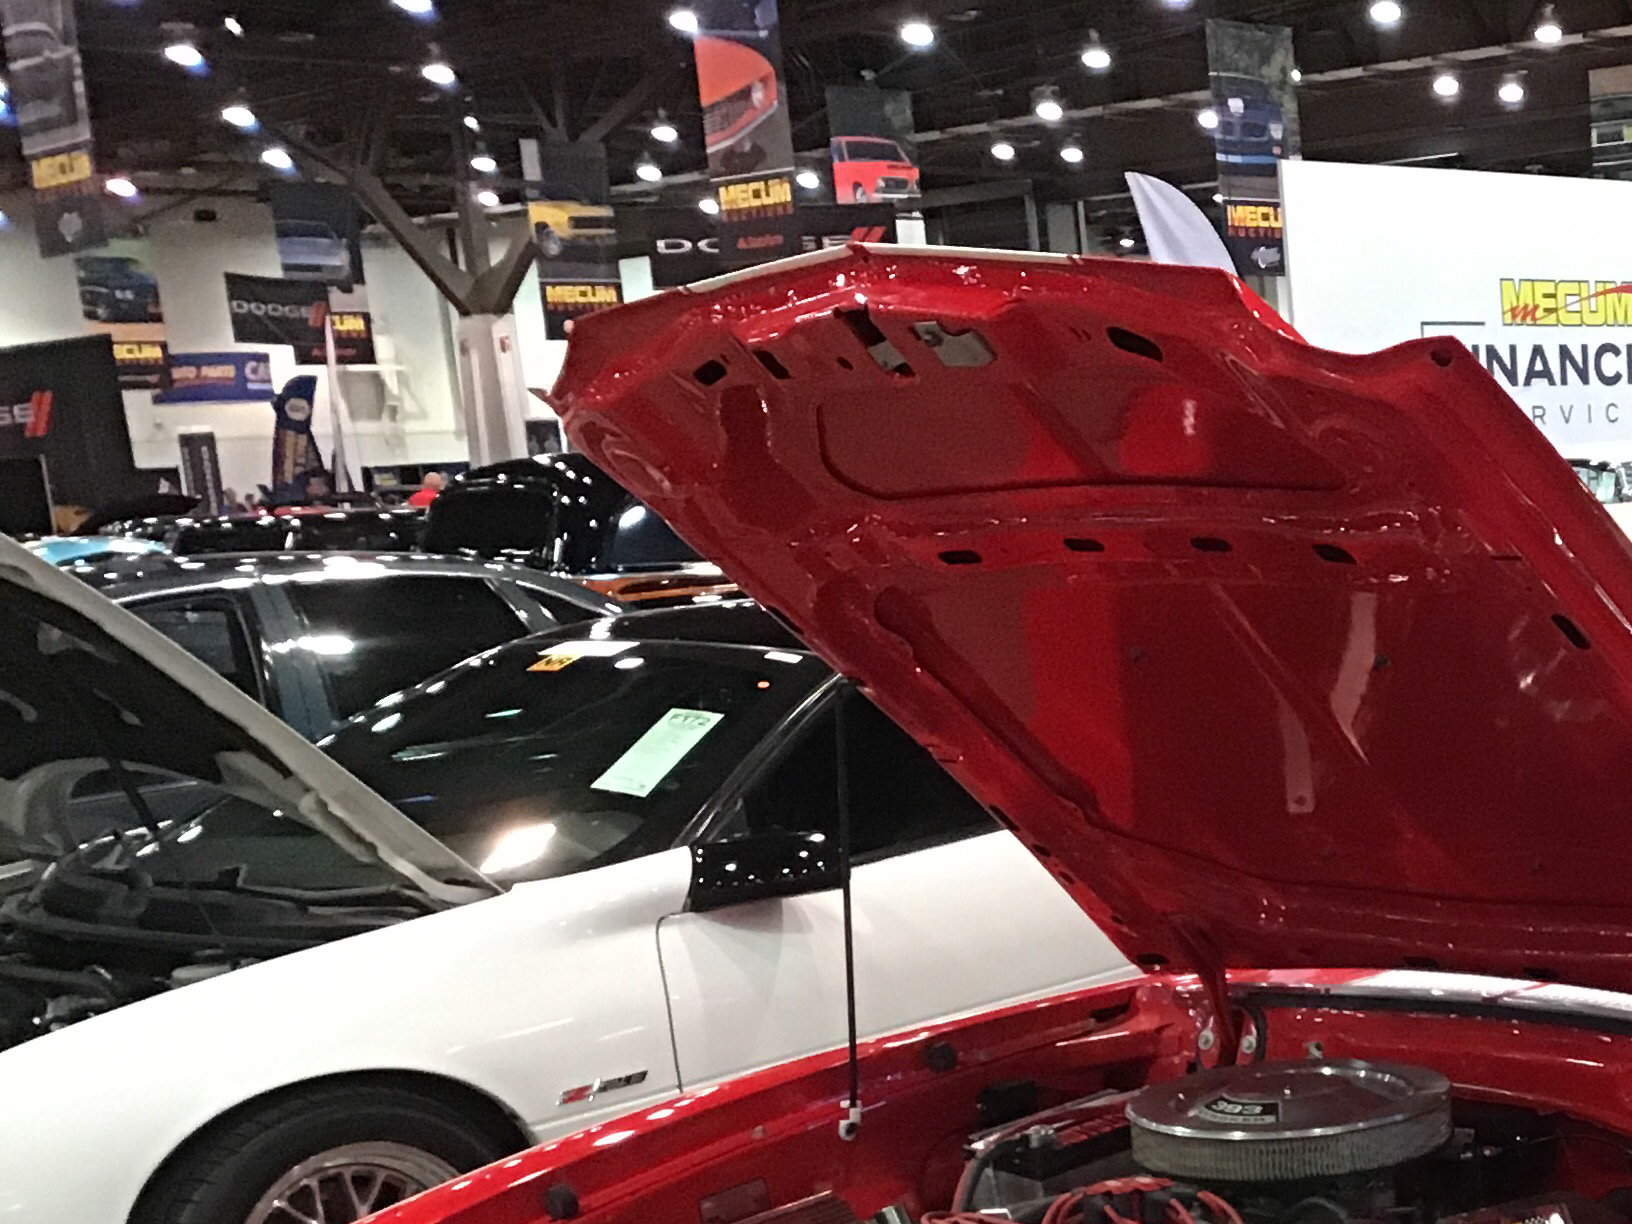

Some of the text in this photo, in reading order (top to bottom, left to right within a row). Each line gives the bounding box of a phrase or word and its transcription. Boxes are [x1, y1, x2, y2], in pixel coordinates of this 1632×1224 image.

[719, 178, 792, 211] MECUM
[1226, 204, 1283, 228] MECU
[546, 285, 618, 304] MECUM
[113, 344, 163, 359] ECUM
